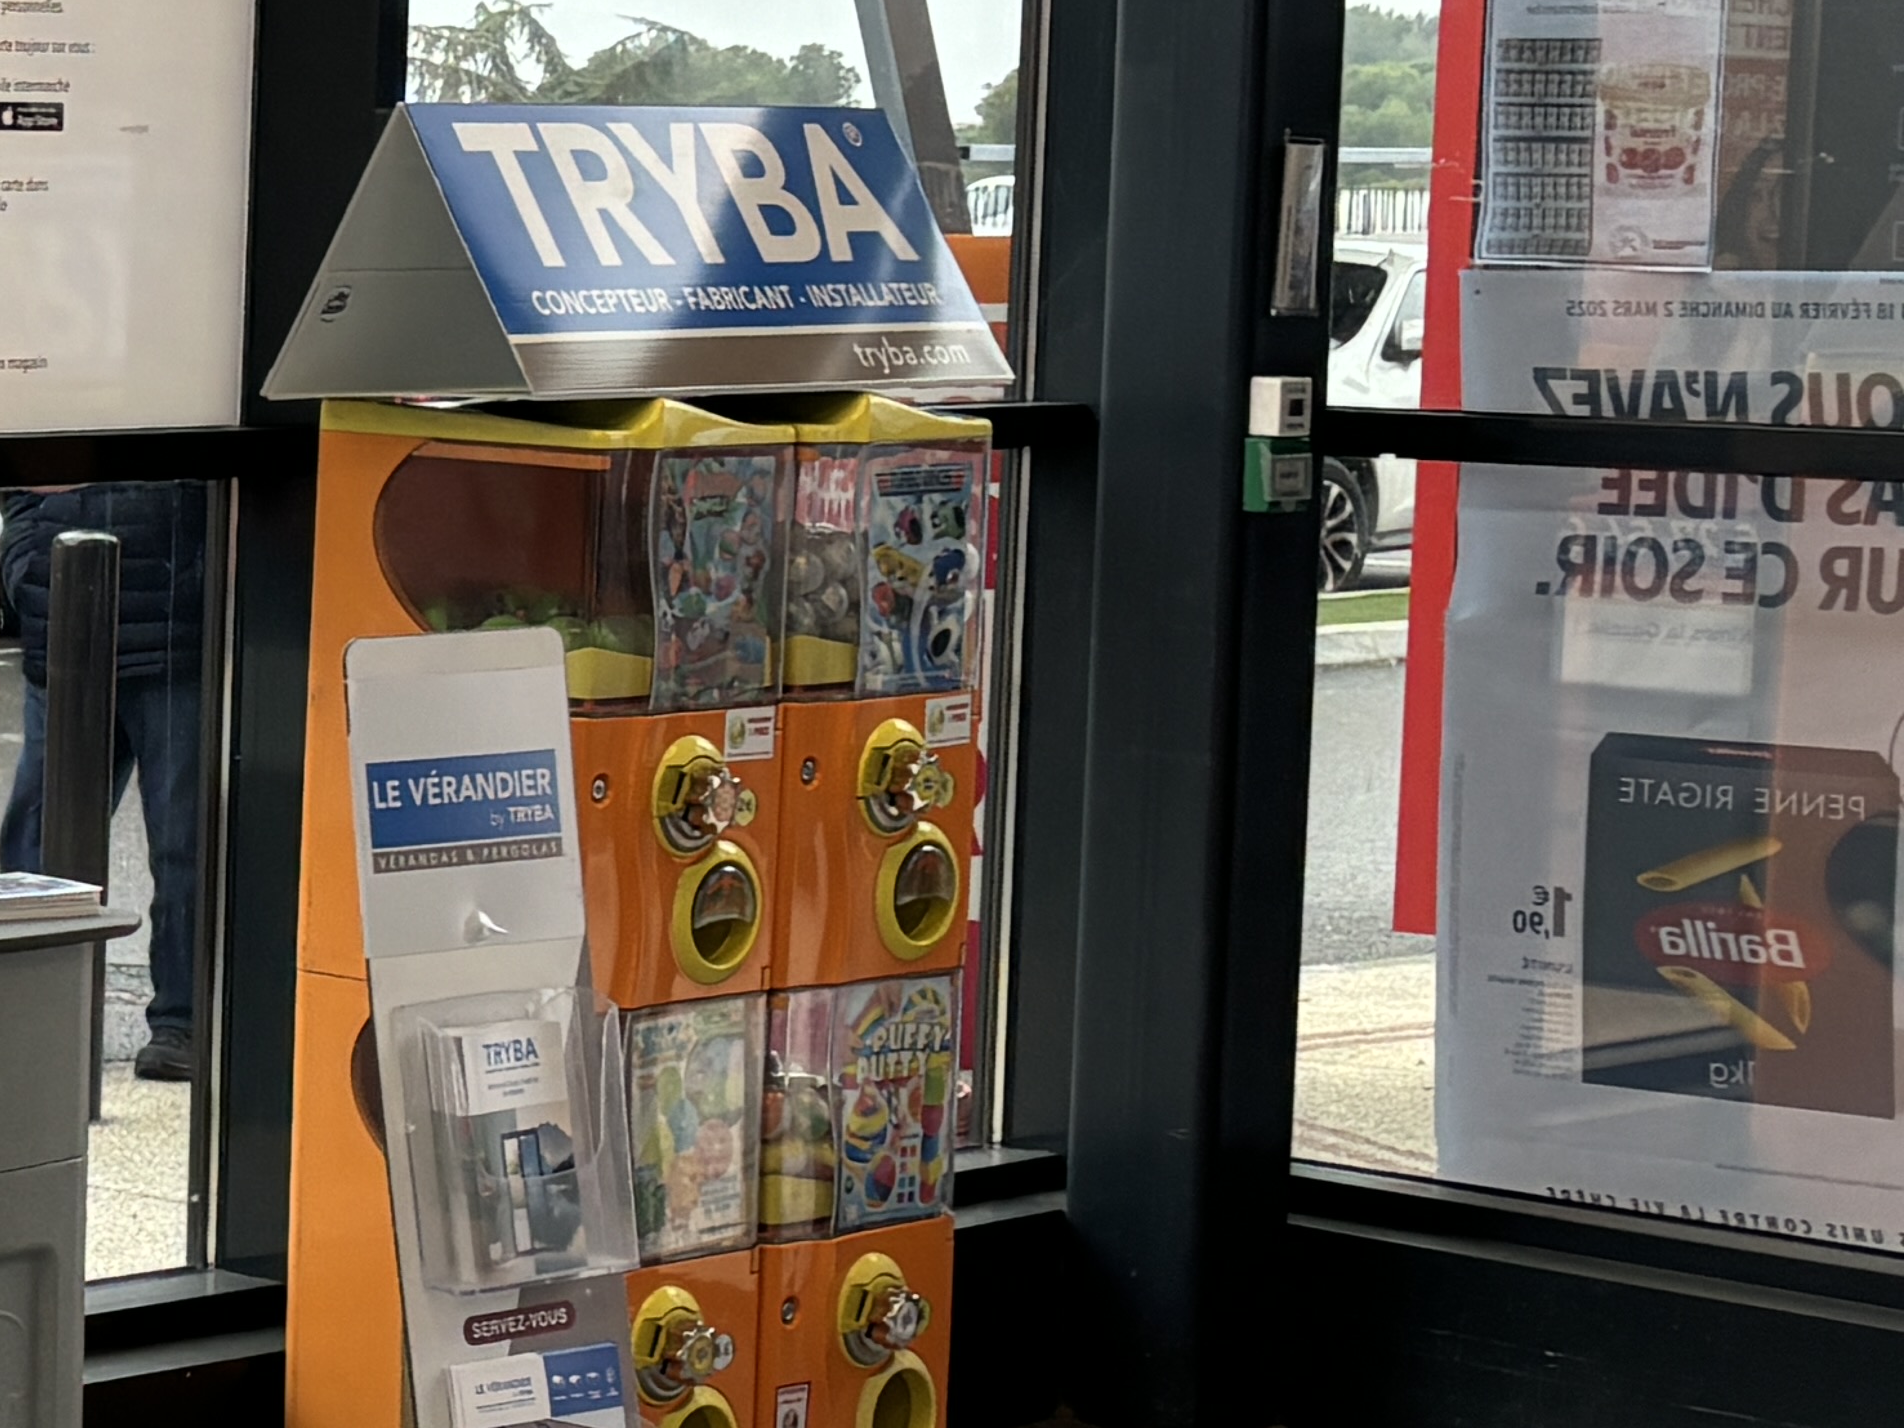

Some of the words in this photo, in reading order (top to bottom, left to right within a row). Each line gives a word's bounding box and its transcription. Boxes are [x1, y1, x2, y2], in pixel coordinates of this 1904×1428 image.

[453, 122, 920, 267] TRYBA
[532, 285, 668, 316] CONCEPTEUR
[685, 283, 794, 312] FABRICANT
[809, 282, 943, 310] INSTALLATEUR
[853, 336, 970, 369] tryba.com
[373, 779, 400, 810] LE
[408, 768, 552, 806] VÉRANDIER
[507, 804, 554, 824] TRYBA
[482, 1036, 540, 1066] TRYBA
[471, 1308, 568, 1339] SERVEZ-VOUS
